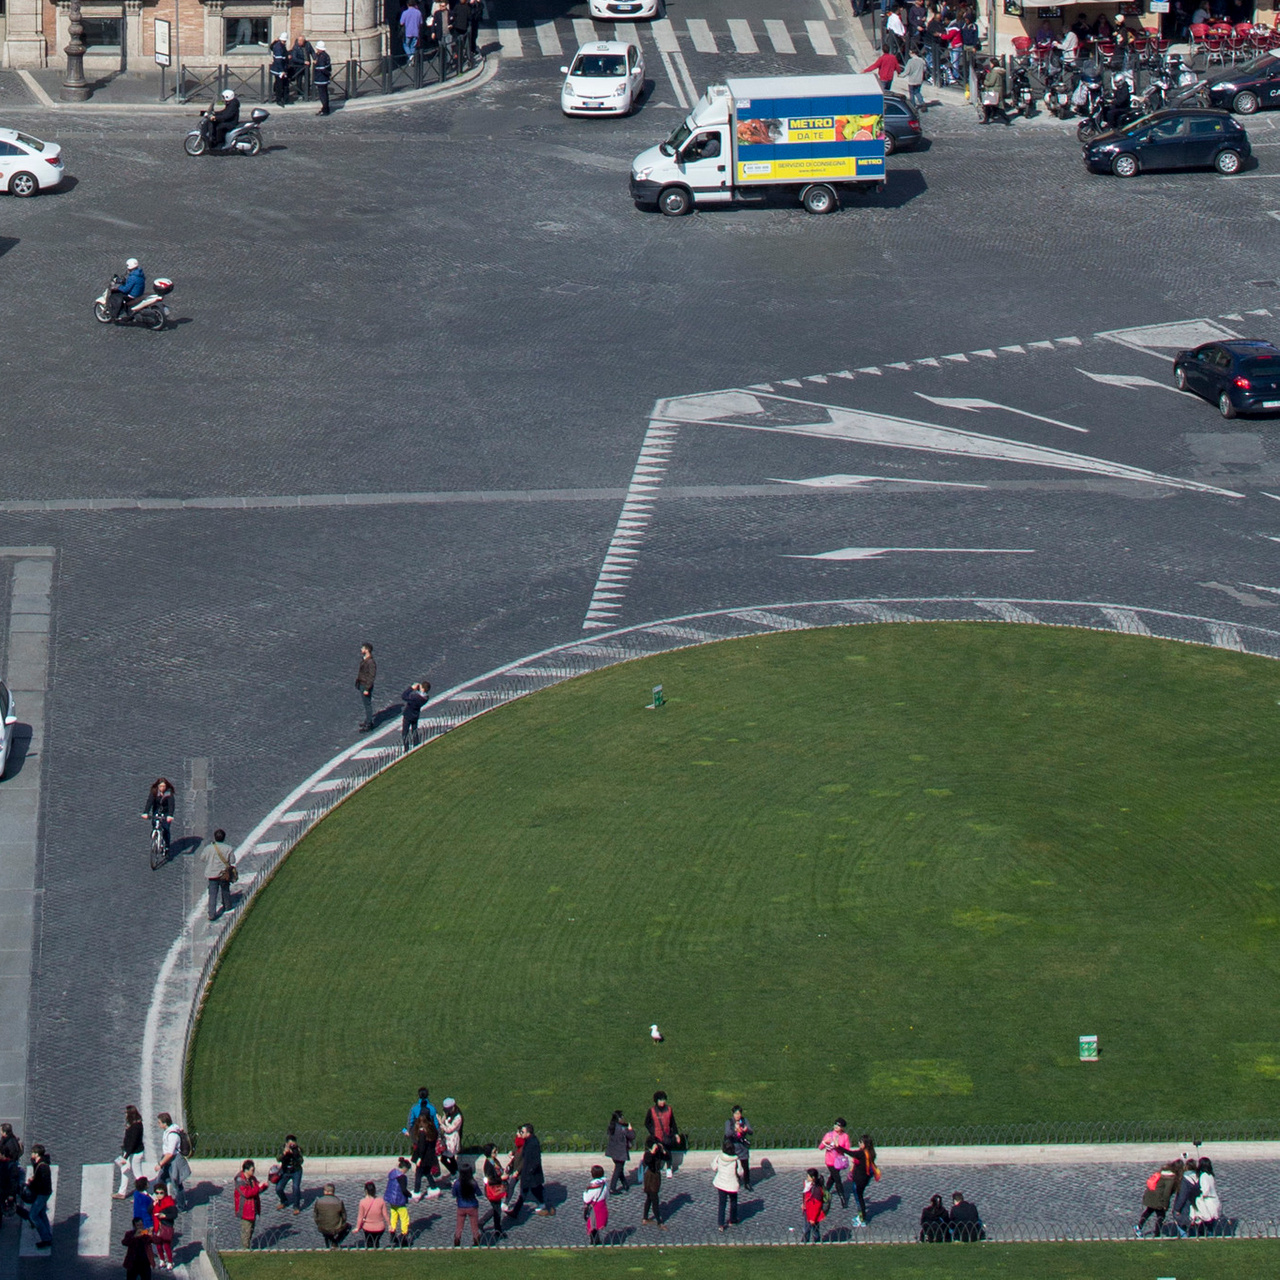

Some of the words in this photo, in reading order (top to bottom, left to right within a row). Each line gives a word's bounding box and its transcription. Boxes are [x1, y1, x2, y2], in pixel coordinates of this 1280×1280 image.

[790, 118, 833, 129] METRO
[797, 132, 810, 140] DA
[813, 131, 824, 139] TE
